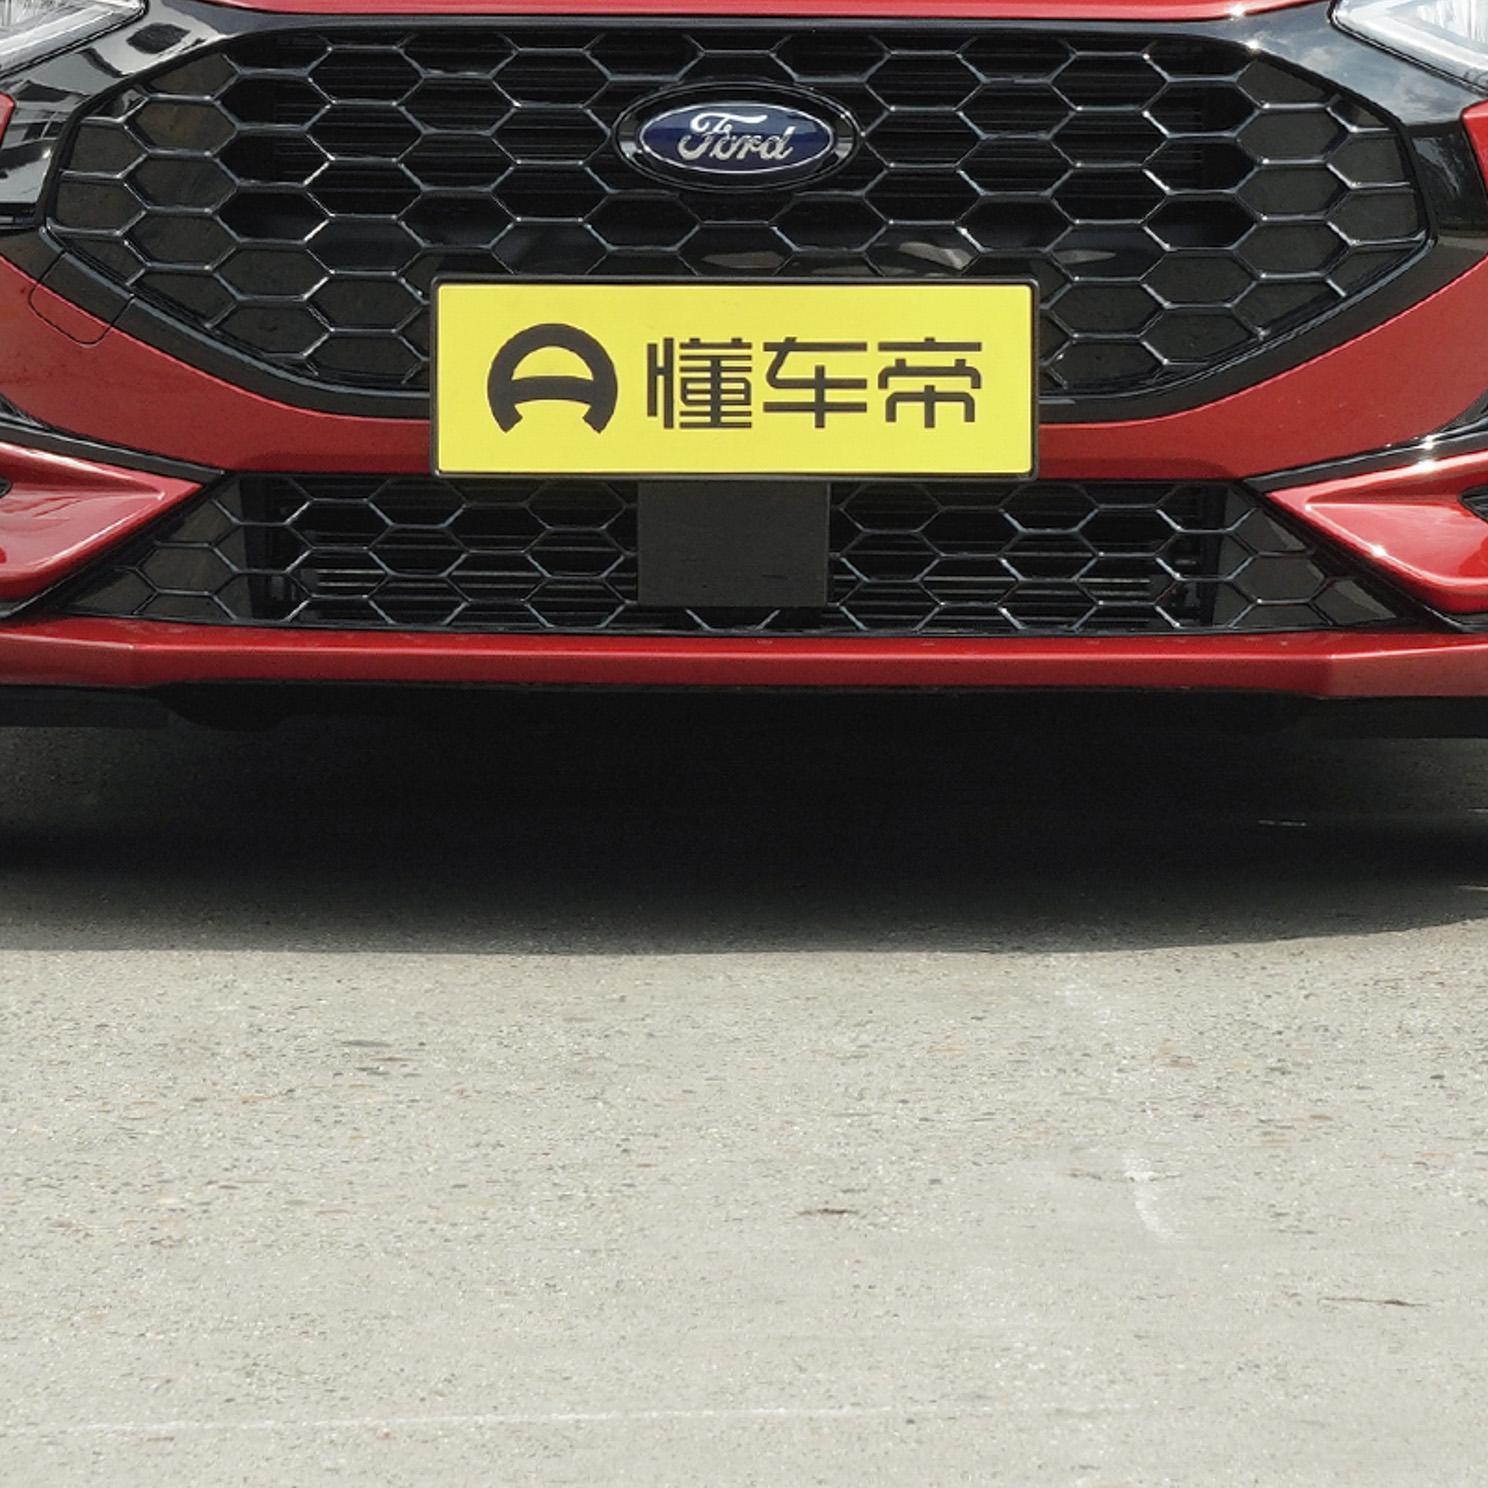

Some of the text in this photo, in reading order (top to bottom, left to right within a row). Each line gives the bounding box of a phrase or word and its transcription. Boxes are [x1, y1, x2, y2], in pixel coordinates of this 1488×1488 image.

[676, 112, 795, 161] Ford
[646, 337, 983, 429] 懂车帝
